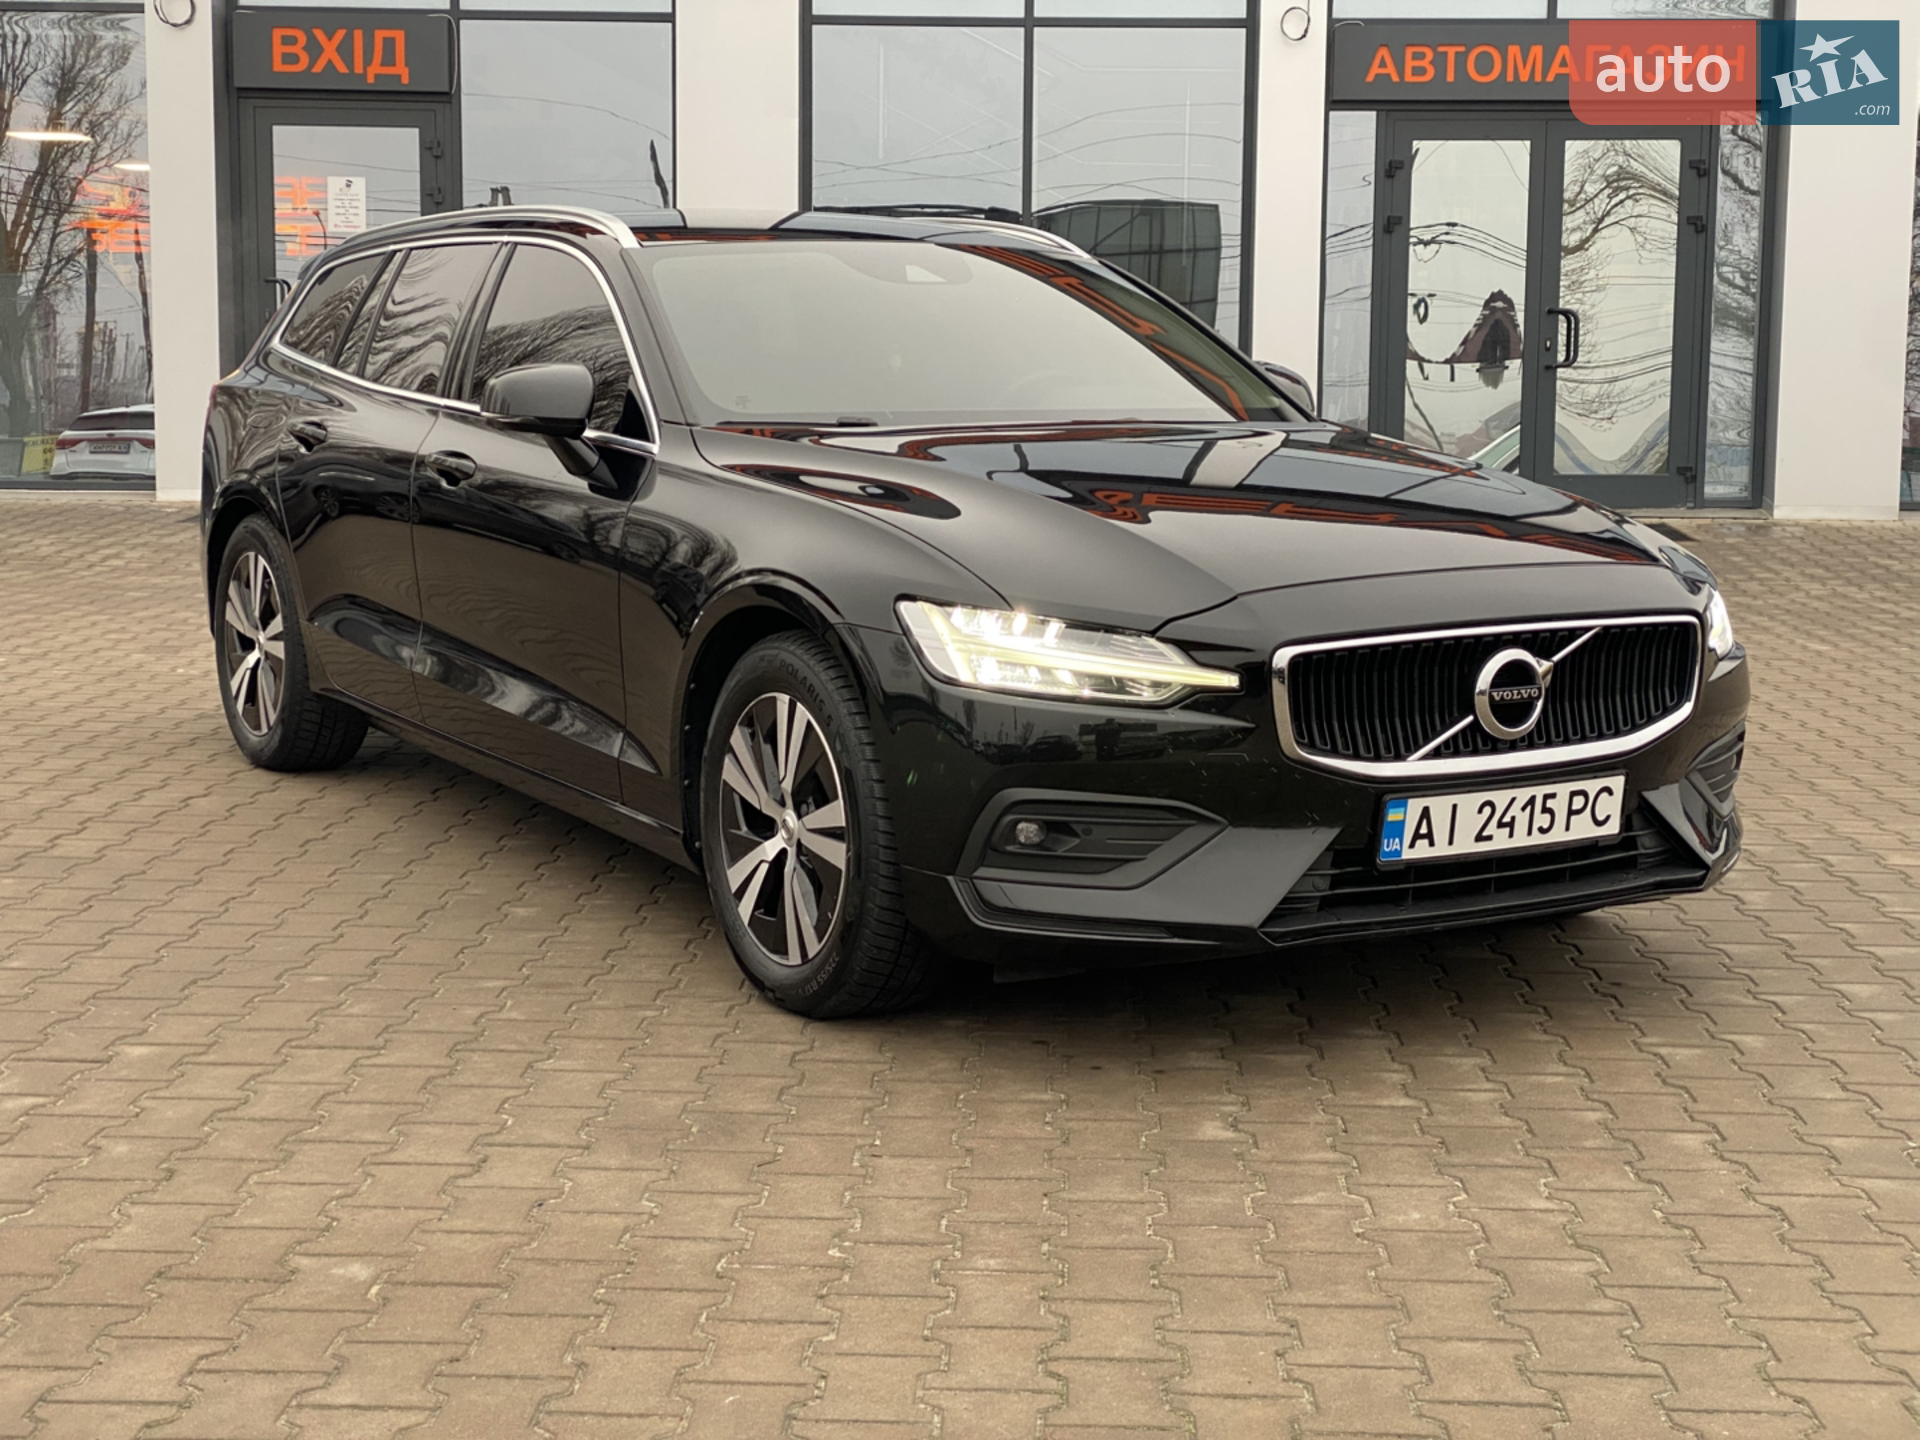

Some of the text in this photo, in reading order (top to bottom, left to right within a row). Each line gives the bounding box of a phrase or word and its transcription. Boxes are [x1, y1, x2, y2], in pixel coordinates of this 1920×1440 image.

[272, 27, 409, 84] ВХІД
[1491, 688, 1539, 700] VOLVO
[1408, 786, 1614, 849] AI 2415 PC
[1384, 837, 1401, 852] UA
